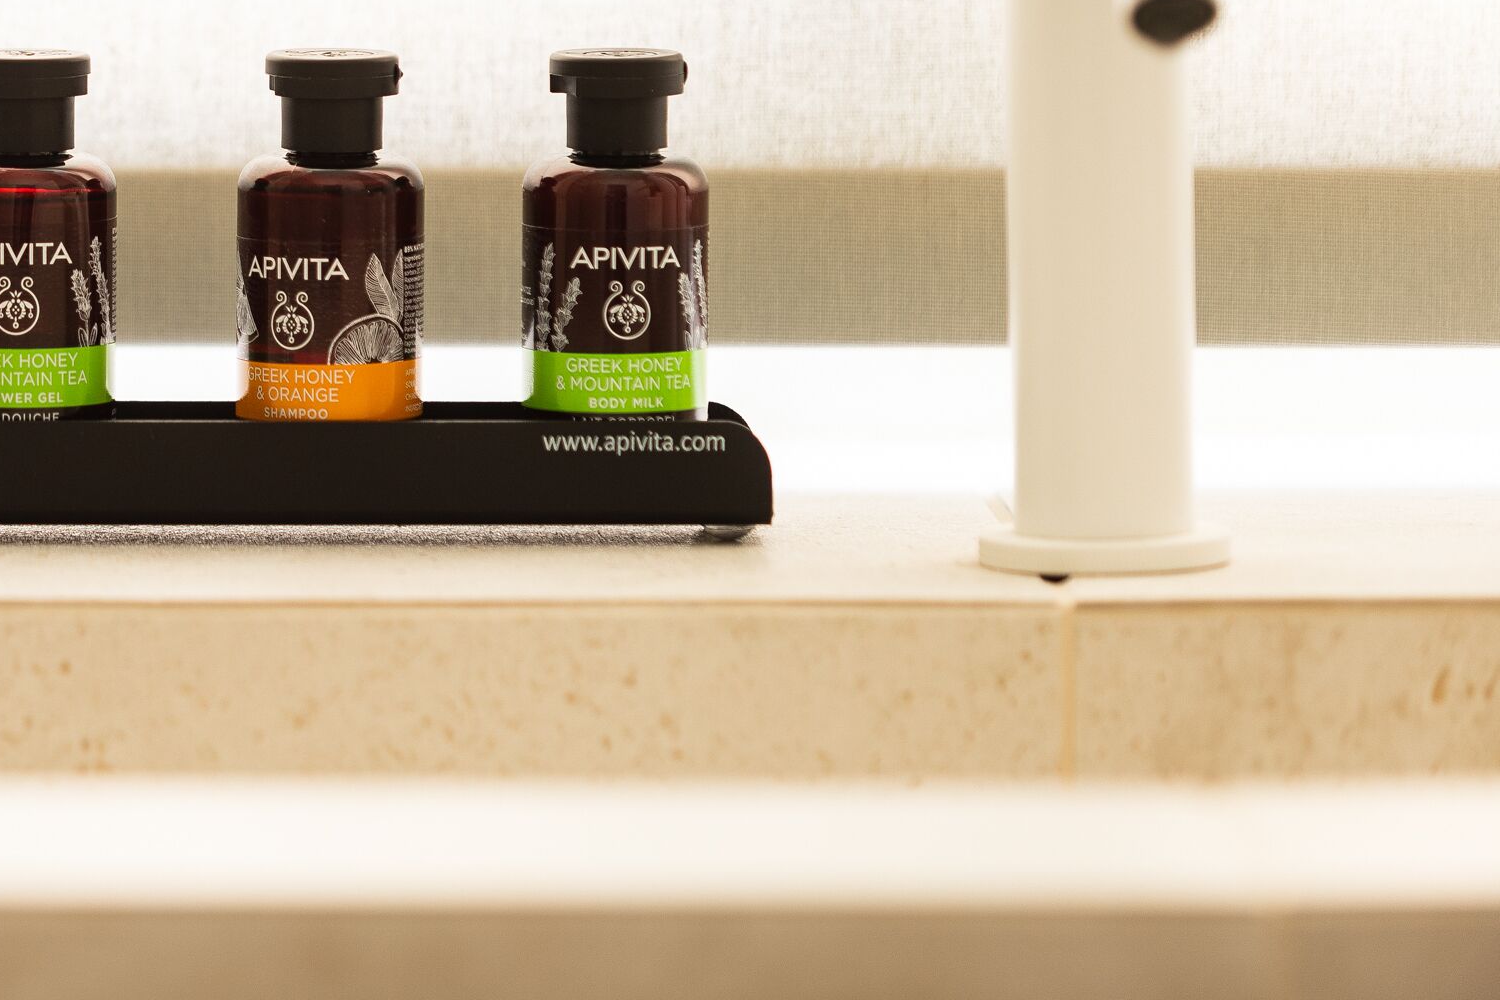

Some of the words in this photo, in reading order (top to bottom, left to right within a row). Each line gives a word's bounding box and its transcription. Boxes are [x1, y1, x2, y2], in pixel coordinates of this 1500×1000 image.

[570, 245, 681, 270] APIVITA
[248, 255, 350, 281] APIVITA
[19, 352, 79, 369] HONEY
[565, 357, 623, 374] GREEK
[628, 357, 683, 373] HONEY
[58, 370, 88, 386] TEA
[247, 367, 289, 384] GREEK
[294, 369, 356, 385] HONEY
[556, 376, 566, 391] &
[570, 375, 661, 392] MOUNTAIN
[665, 374, 692, 390] TEA
[38, 391, 64, 404] GEL
[256, 386, 265, 401] &
[268, 387, 339, 403] ORANGE
[588, 397, 628, 410] BODY
[632, 396, 664, 409] MILK
[264, 407, 329, 420] SHAMPOO
[542, 430, 726, 456] www.apivita.com
